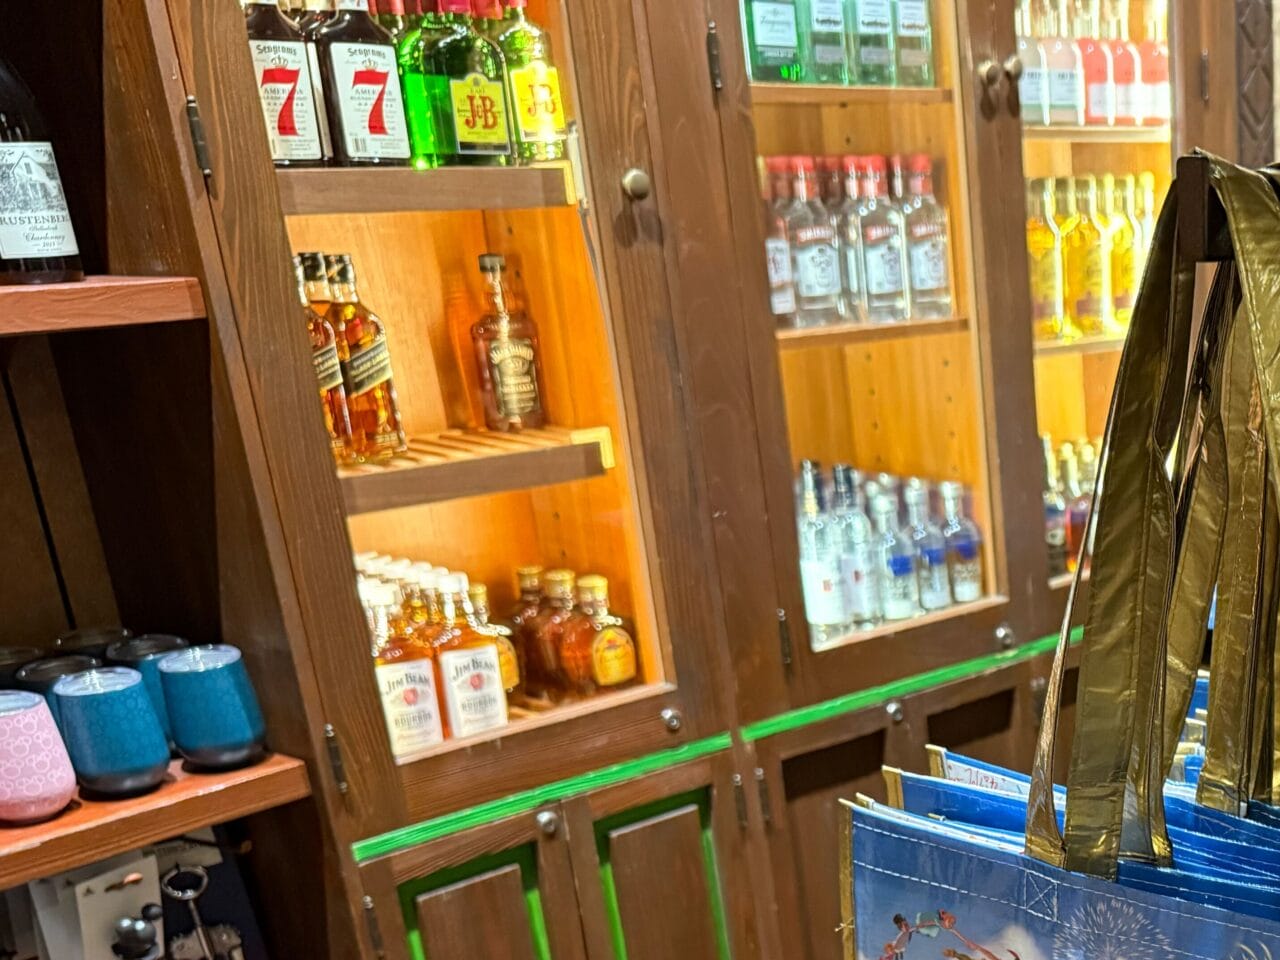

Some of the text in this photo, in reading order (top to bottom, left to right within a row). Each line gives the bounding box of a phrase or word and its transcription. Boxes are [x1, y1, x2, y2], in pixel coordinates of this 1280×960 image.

[261, 67, 300, 136] 7
[352, 70, 389, 135] 7
[385, 677, 404, 695] JIM
[452, 662, 471, 681] JIM
